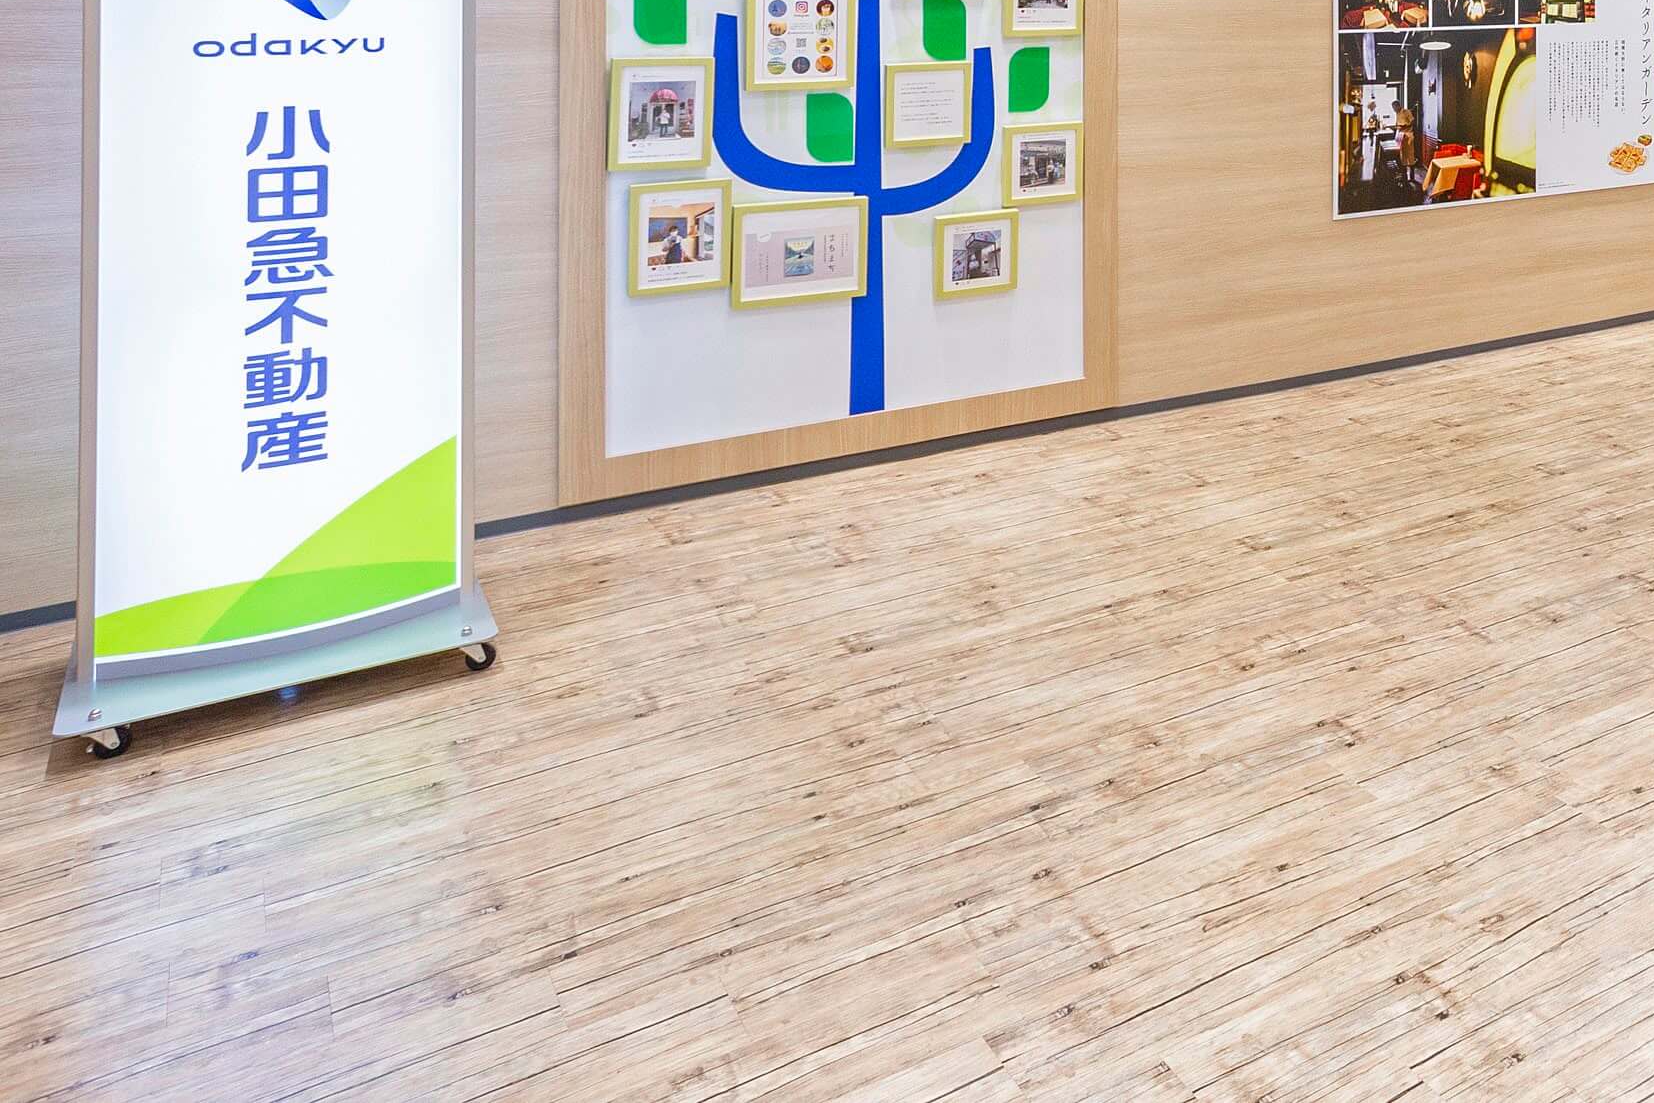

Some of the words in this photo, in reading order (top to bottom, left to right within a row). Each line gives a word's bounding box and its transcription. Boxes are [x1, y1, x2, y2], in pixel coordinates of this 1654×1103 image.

[192, 32, 386, 58] odakyu
[240, 105, 335, 473] 小田急不動産
